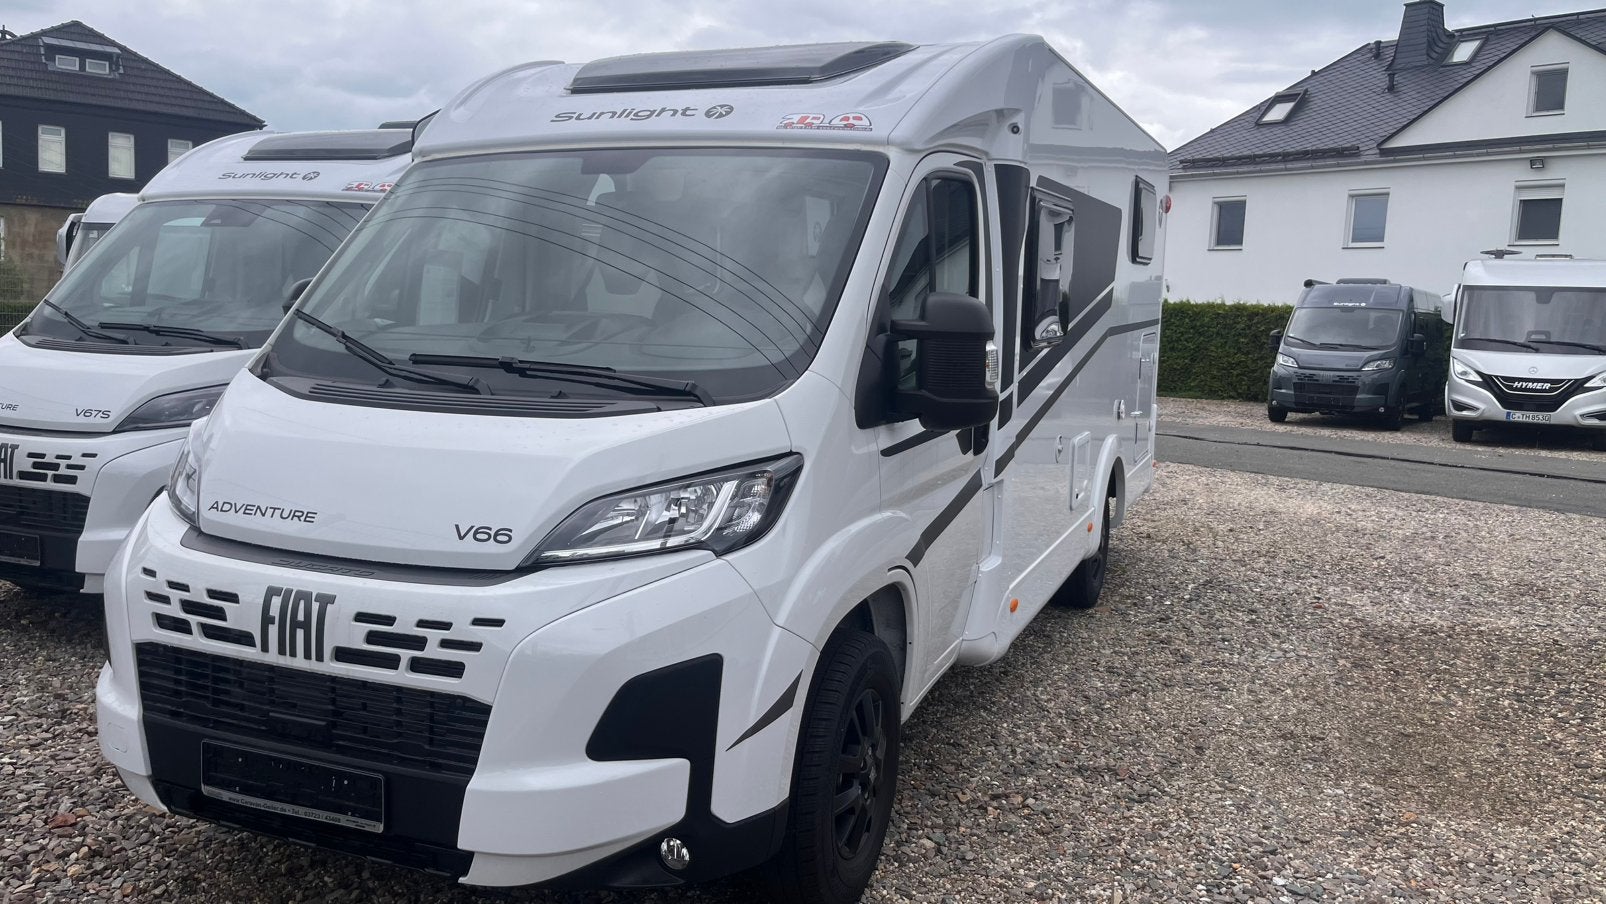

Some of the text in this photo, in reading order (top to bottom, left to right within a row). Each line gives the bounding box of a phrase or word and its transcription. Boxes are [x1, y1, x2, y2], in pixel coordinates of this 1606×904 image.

[1513, 381, 1551, 390] HYMER
[75, 407, 112, 419] V67S
[208, 500, 318, 524] ADVENTURE
[454, 523, 513, 545] V66
[260, 585, 337, 663] FIAT
